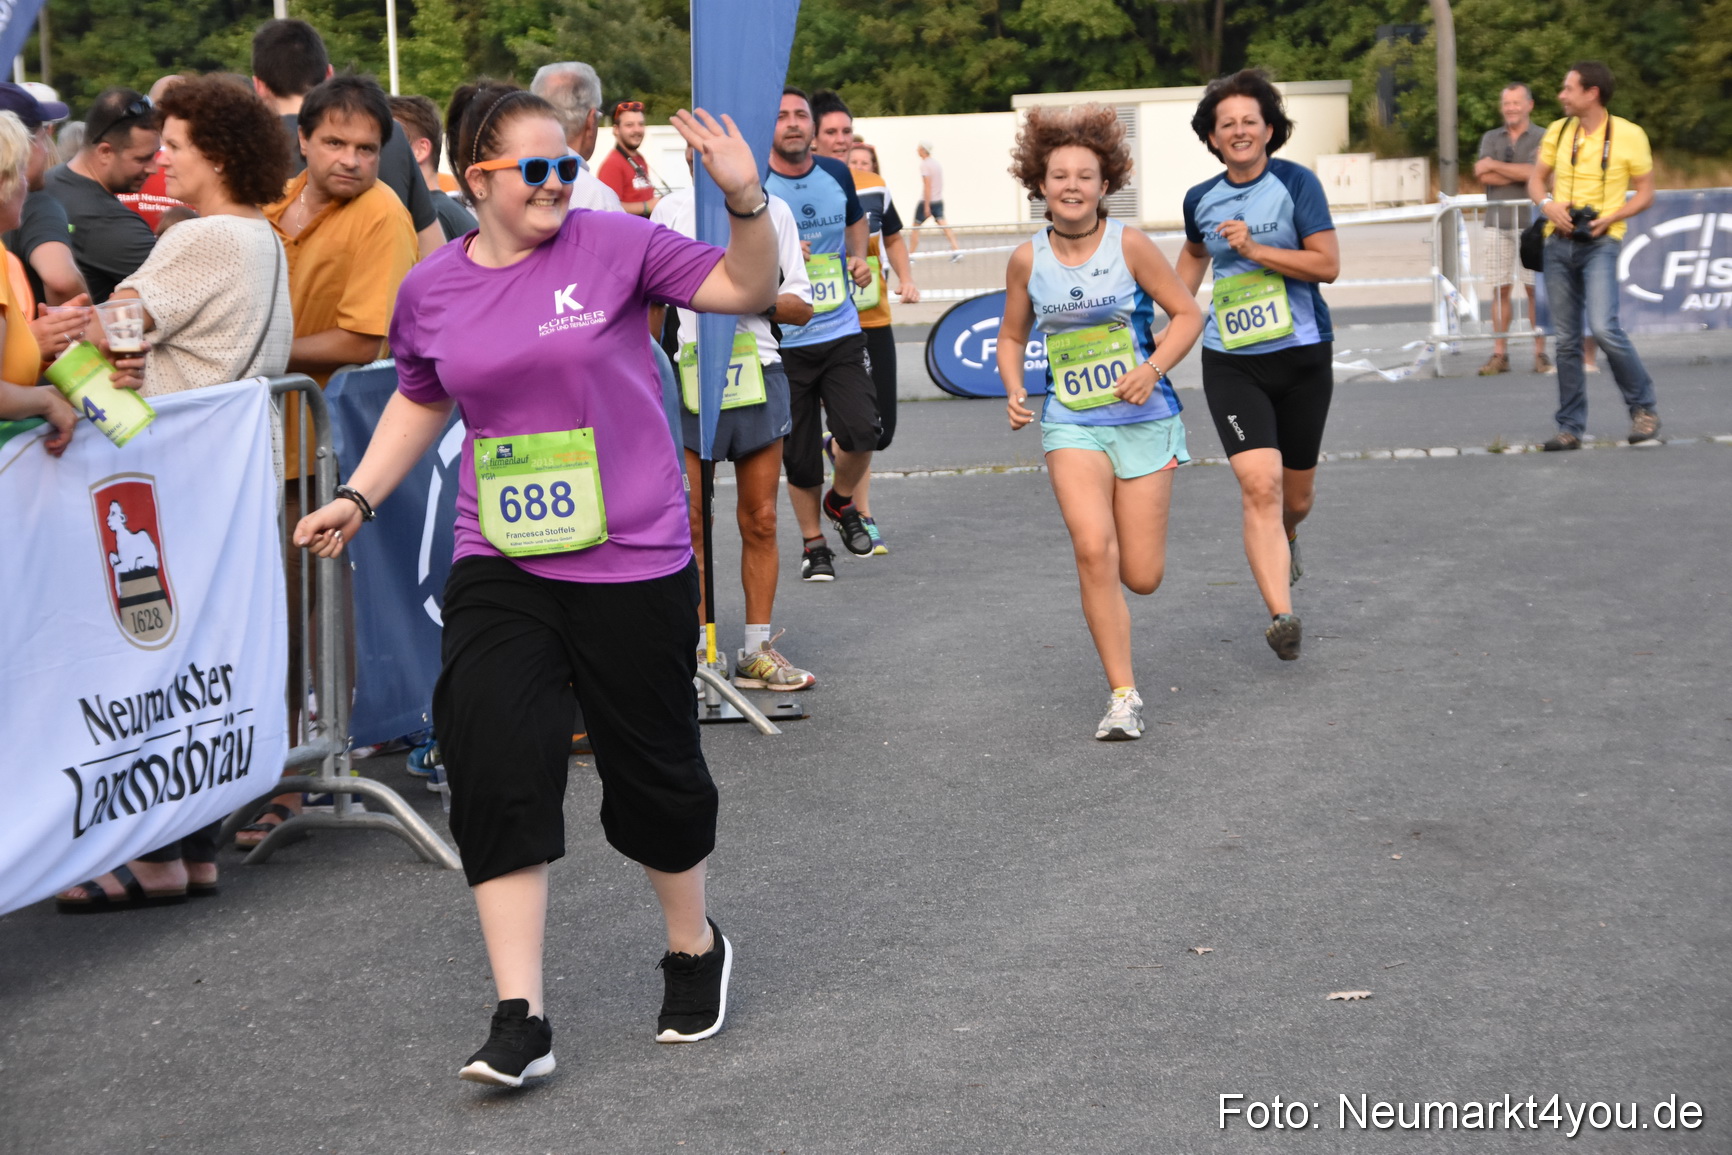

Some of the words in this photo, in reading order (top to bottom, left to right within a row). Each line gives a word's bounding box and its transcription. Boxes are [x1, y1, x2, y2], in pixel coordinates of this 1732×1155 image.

[797, 214, 843, 230] ABMÜLLER
[803, 232, 822, 240] TEAM
[554, 283, 584, 315] K
[1042, 295, 1117, 314] SCHABMÜLLER
[538, 310, 605, 331] KÜFNER
[556, 323, 569, 331] UND
[1225, 301, 1278, 334] 6081
[1064, 360, 1127, 395] 6100
[490, 454, 529, 467] firmenlauf
[499, 481, 575, 523] 688
[506, 529, 544, 539] Francesca
[545, 526, 576, 536] Stoffels
[130, 607, 163, 634] 1628
